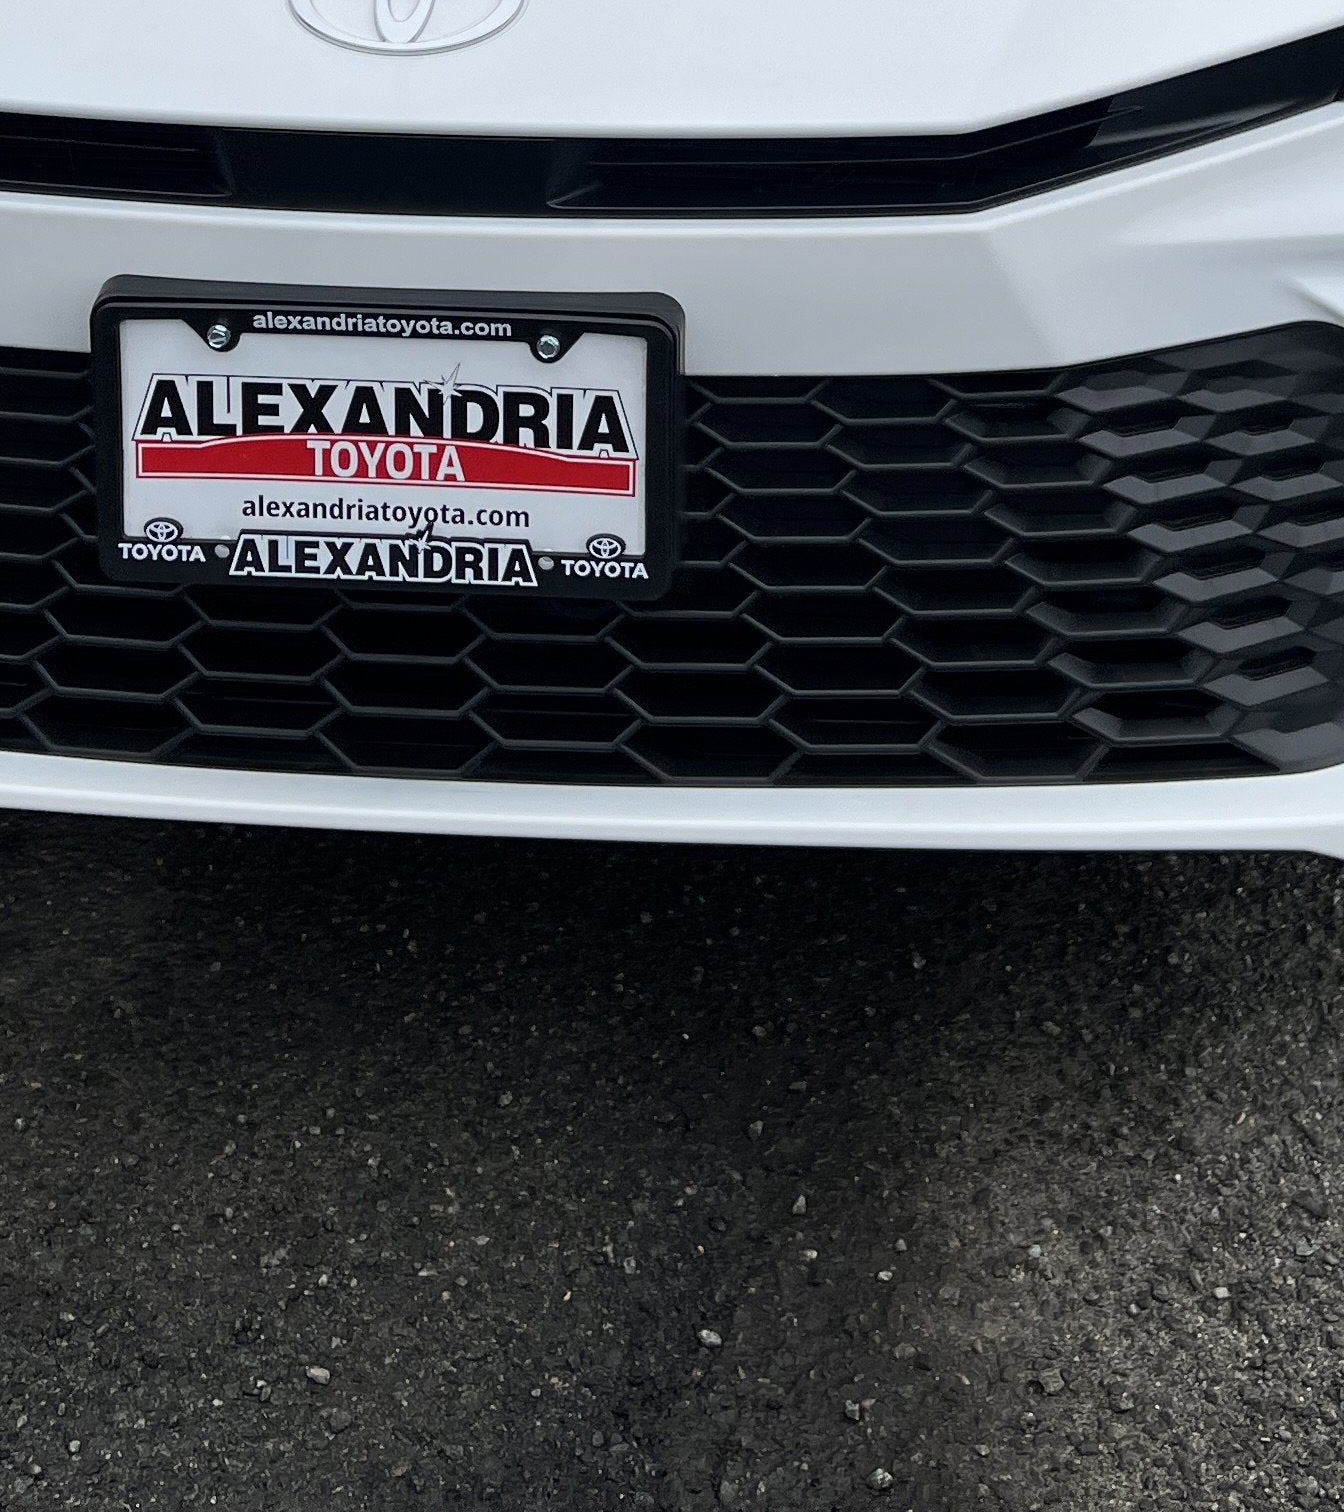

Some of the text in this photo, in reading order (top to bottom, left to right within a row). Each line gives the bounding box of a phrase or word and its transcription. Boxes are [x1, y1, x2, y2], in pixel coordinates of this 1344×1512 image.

[252, 311, 513, 339] alexandriatoyota.com
[137, 375, 632, 456] ALEXANDRIA
[306, 440, 466, 483] TOYOTA
[241, 495, 531, 530] alexandriatoyota.com
[117, 542, 207, 563] TOYOTA
[230, 532, 538, 587] ALEXANDRIA
[560, 559, 649, 580] TOYOTA
